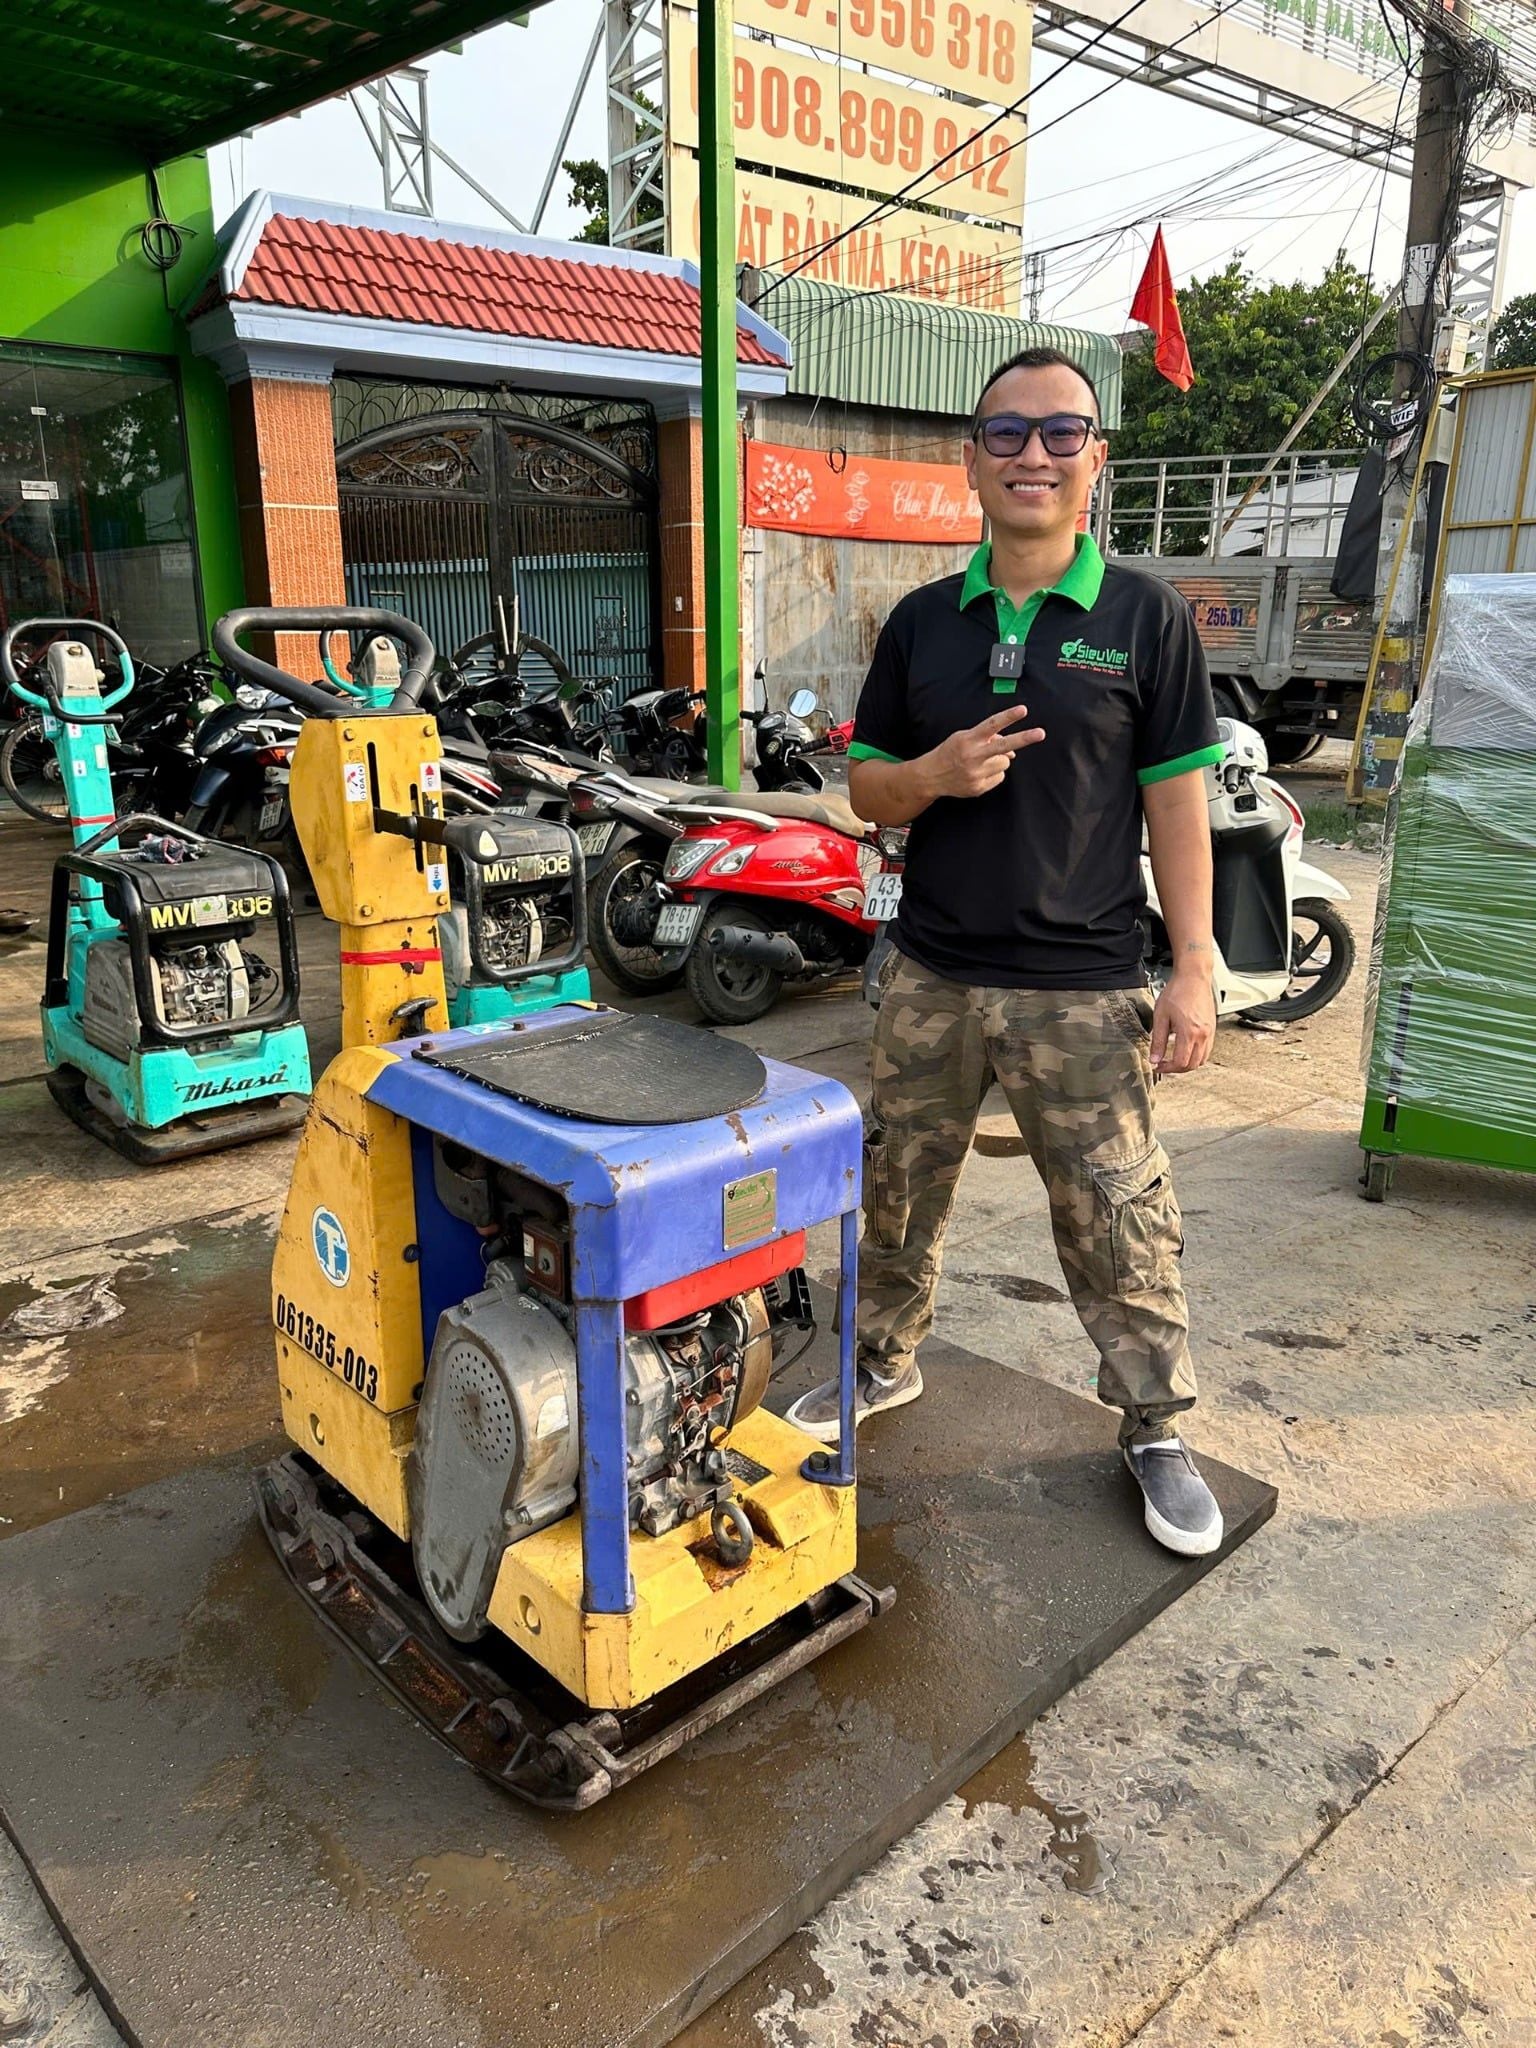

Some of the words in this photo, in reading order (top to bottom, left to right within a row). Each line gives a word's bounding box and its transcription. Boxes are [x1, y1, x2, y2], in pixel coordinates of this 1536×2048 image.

[947, 2, 1016, 85] 318
[933, 118, 1010, 197] 942
[783, 195, 840, 282] BẢN
[901, 224, 951, 301] KÈO
[957, 241, 1006, 313] NHÀ
[175, 1063, 289, 1103] Mikasa
[276, 1293, 379, 1402] 061335-003
